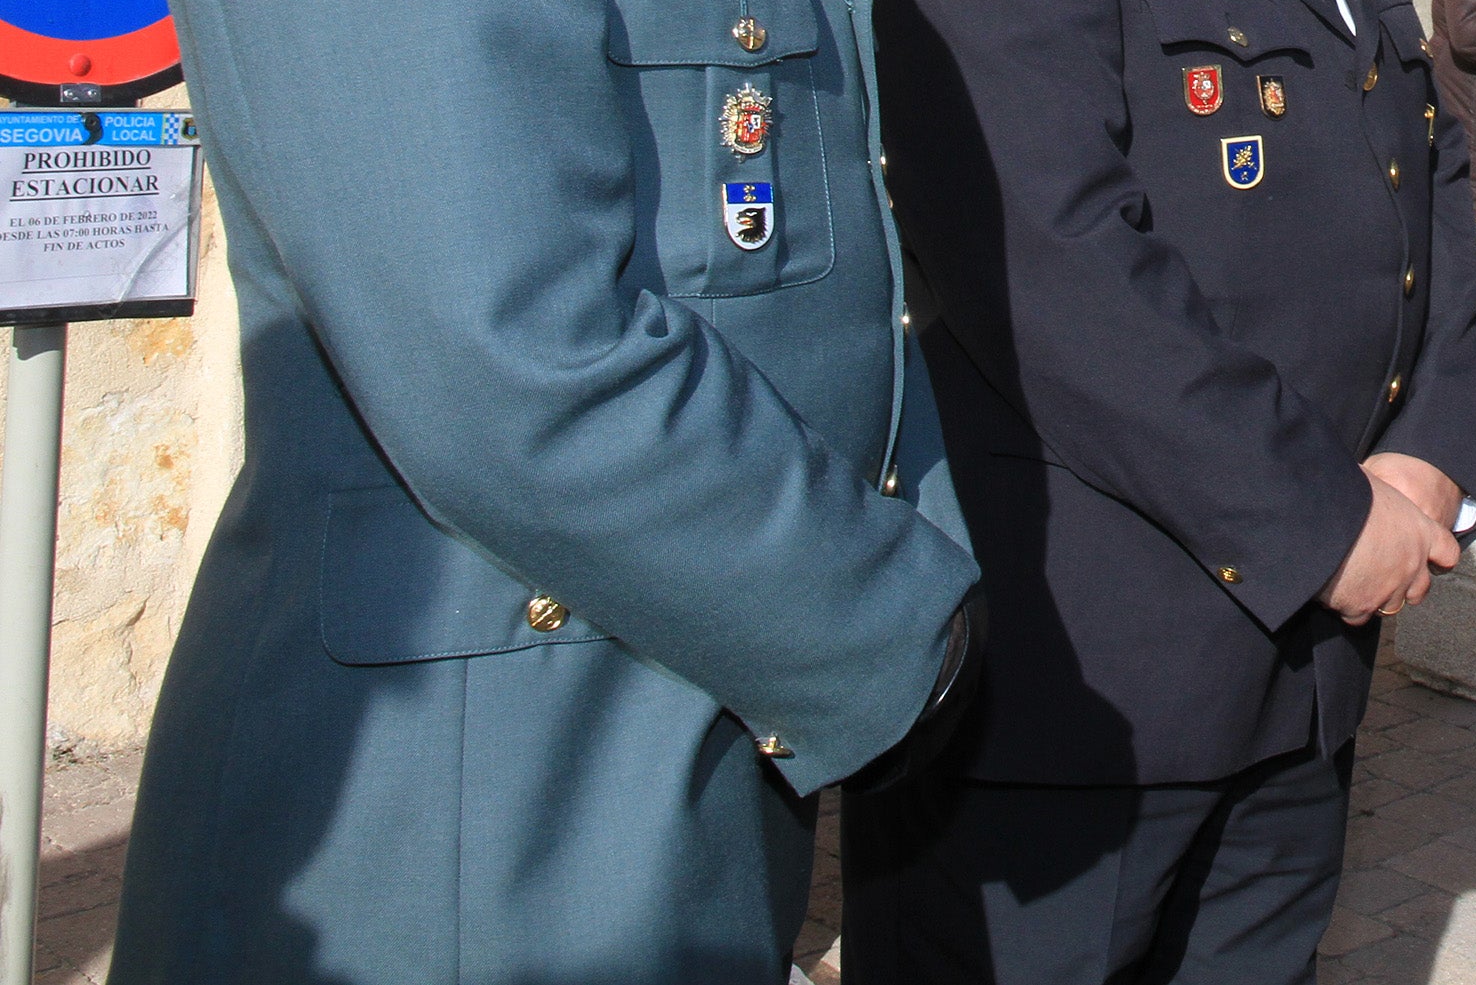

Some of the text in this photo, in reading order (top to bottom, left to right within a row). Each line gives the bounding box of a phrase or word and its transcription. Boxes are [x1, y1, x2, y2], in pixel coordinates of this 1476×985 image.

[66, 115, 79, 124] DE
[104, 116, 156, 128] POLICIA
[0, 128, 83, 143] SEGOVIA
[112, 129, 157, 141] LOCAL
[24, 149, 152, 169] PROHIBIDO
[10, 175, 159, 197] ESTACIONAR
[10, 210, 158, 227] EL 06 DE FEBRERO DE 2022
[37, 229, 60, 240] LAS
[63, 227, 90, 238] 07:00
[92, 224, 132, 236] HORAS
[134, 223, 169, 234] HASTA
[43, 238, 126, 252] FIN DE ACTOS
